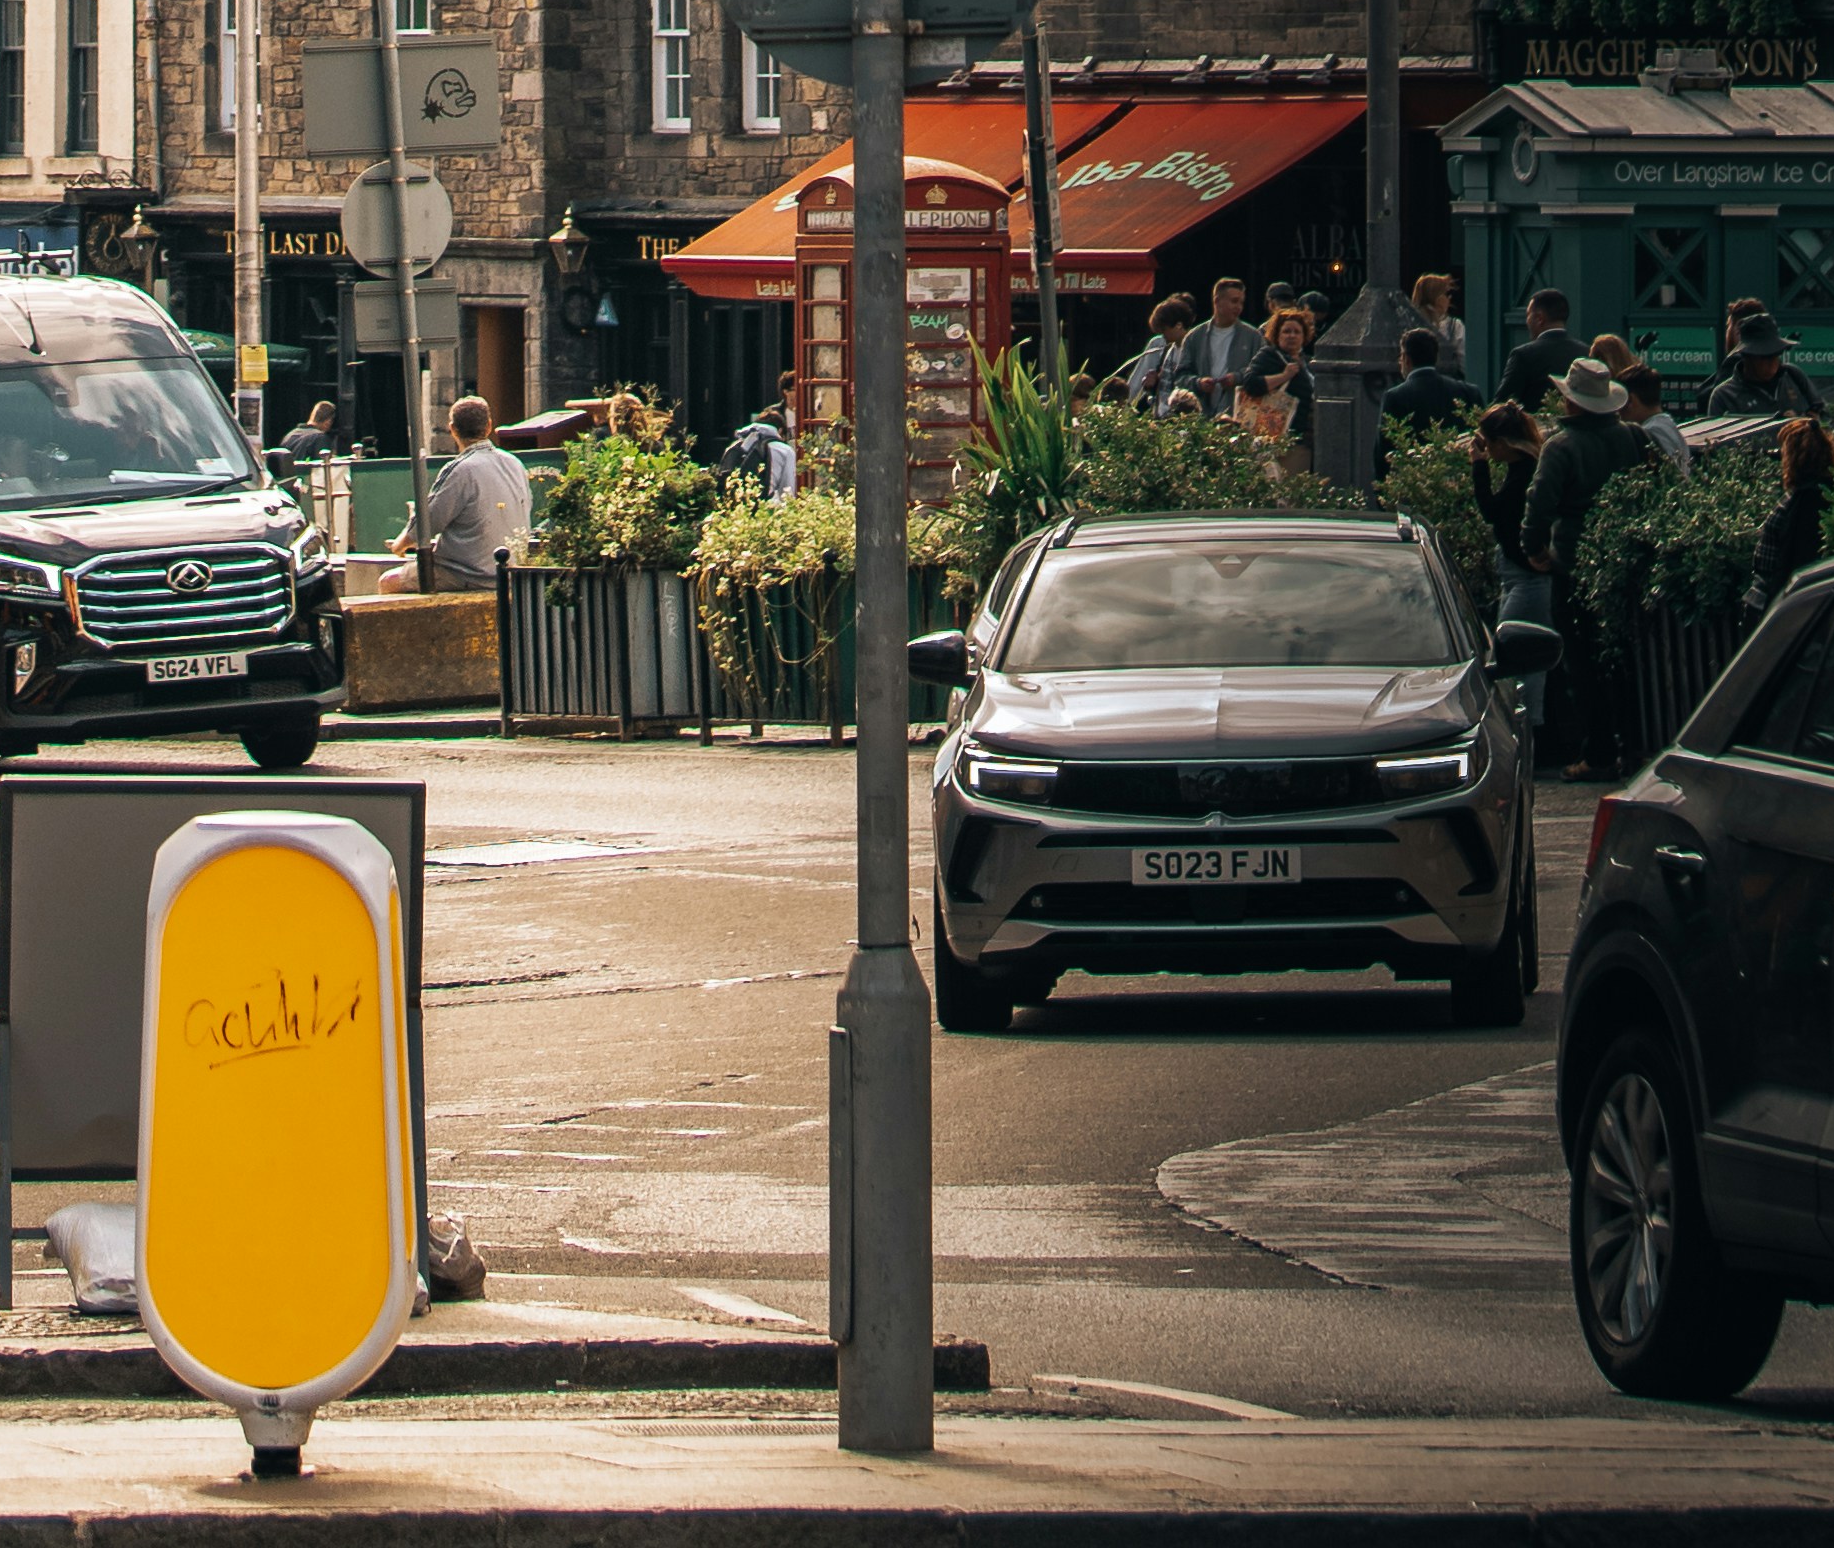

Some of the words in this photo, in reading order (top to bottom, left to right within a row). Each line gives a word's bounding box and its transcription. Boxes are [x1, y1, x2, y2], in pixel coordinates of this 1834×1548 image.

[1525, 38, 1646, 77] MAGGIE
[1139, 151, 1238, 202] Bistro
[1614, 161, 1664, 183] Over
[1673, 161, 1764, 188] Langshaw
[1773, 163, 1803, 183] Ice
[908, 210, 988, 227] LEPHONE
[270, 232, 318, 254] LAST
[637, 235, 680, 260] THE
[1288, 224, 1364, 260] ALBA
[755, 279, 780, 296] Late
[1081, 273, 1107, 290] Late
[1292, 261, 1364, 289] BISTRO
[1672, 352, 1713, 363] cream
[153, 659, 200, 679] SG24
[204, 655, 238, 675] VFL
[1144, 851, 1223, 879] SO23
[1230, 850, 1289, 878] FJN
